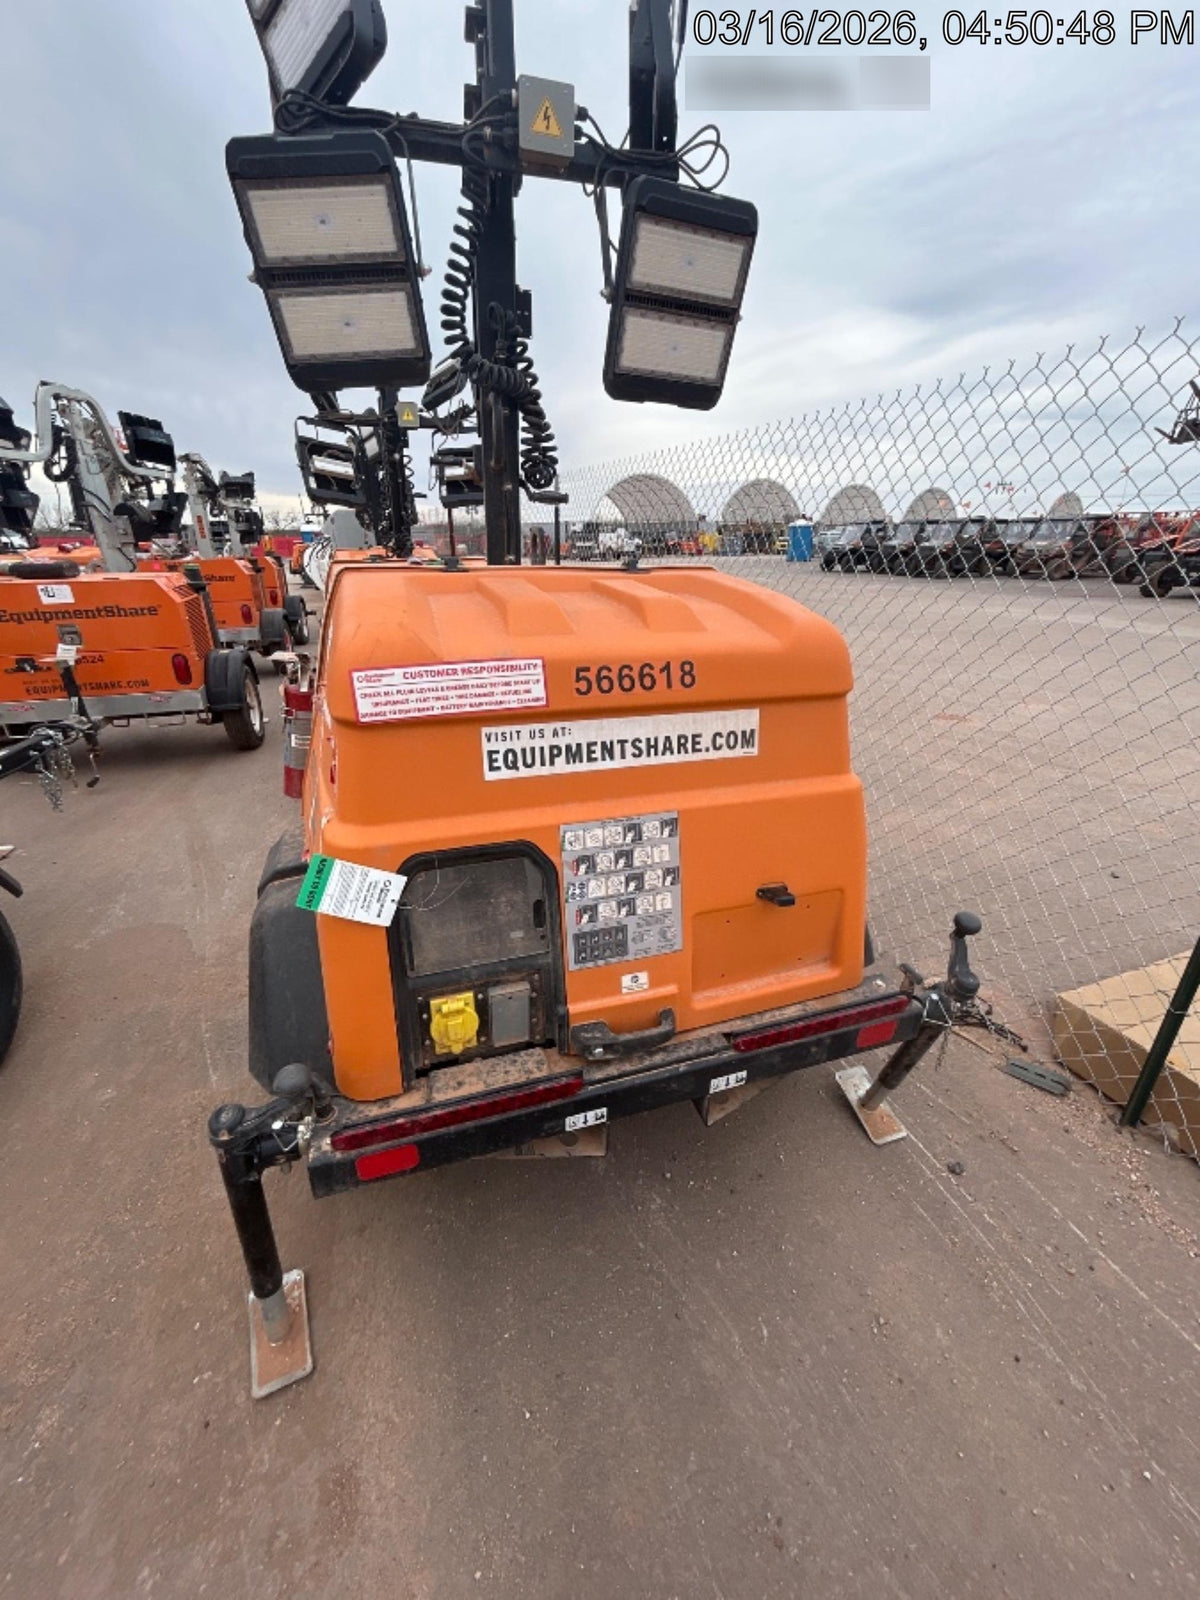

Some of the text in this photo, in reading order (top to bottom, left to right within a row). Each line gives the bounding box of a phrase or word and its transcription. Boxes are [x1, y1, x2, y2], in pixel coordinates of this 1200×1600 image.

[403, 668, 459, 680] CUSTOMER
[461, 663, 538, 676] RESPONSIBILITY
[574, 660, 697, 696] 566618
[485, 726, 572, 744] VISIT US AT:
[486, 728, 757, 772] EQUIPMENTSHARE.COM
